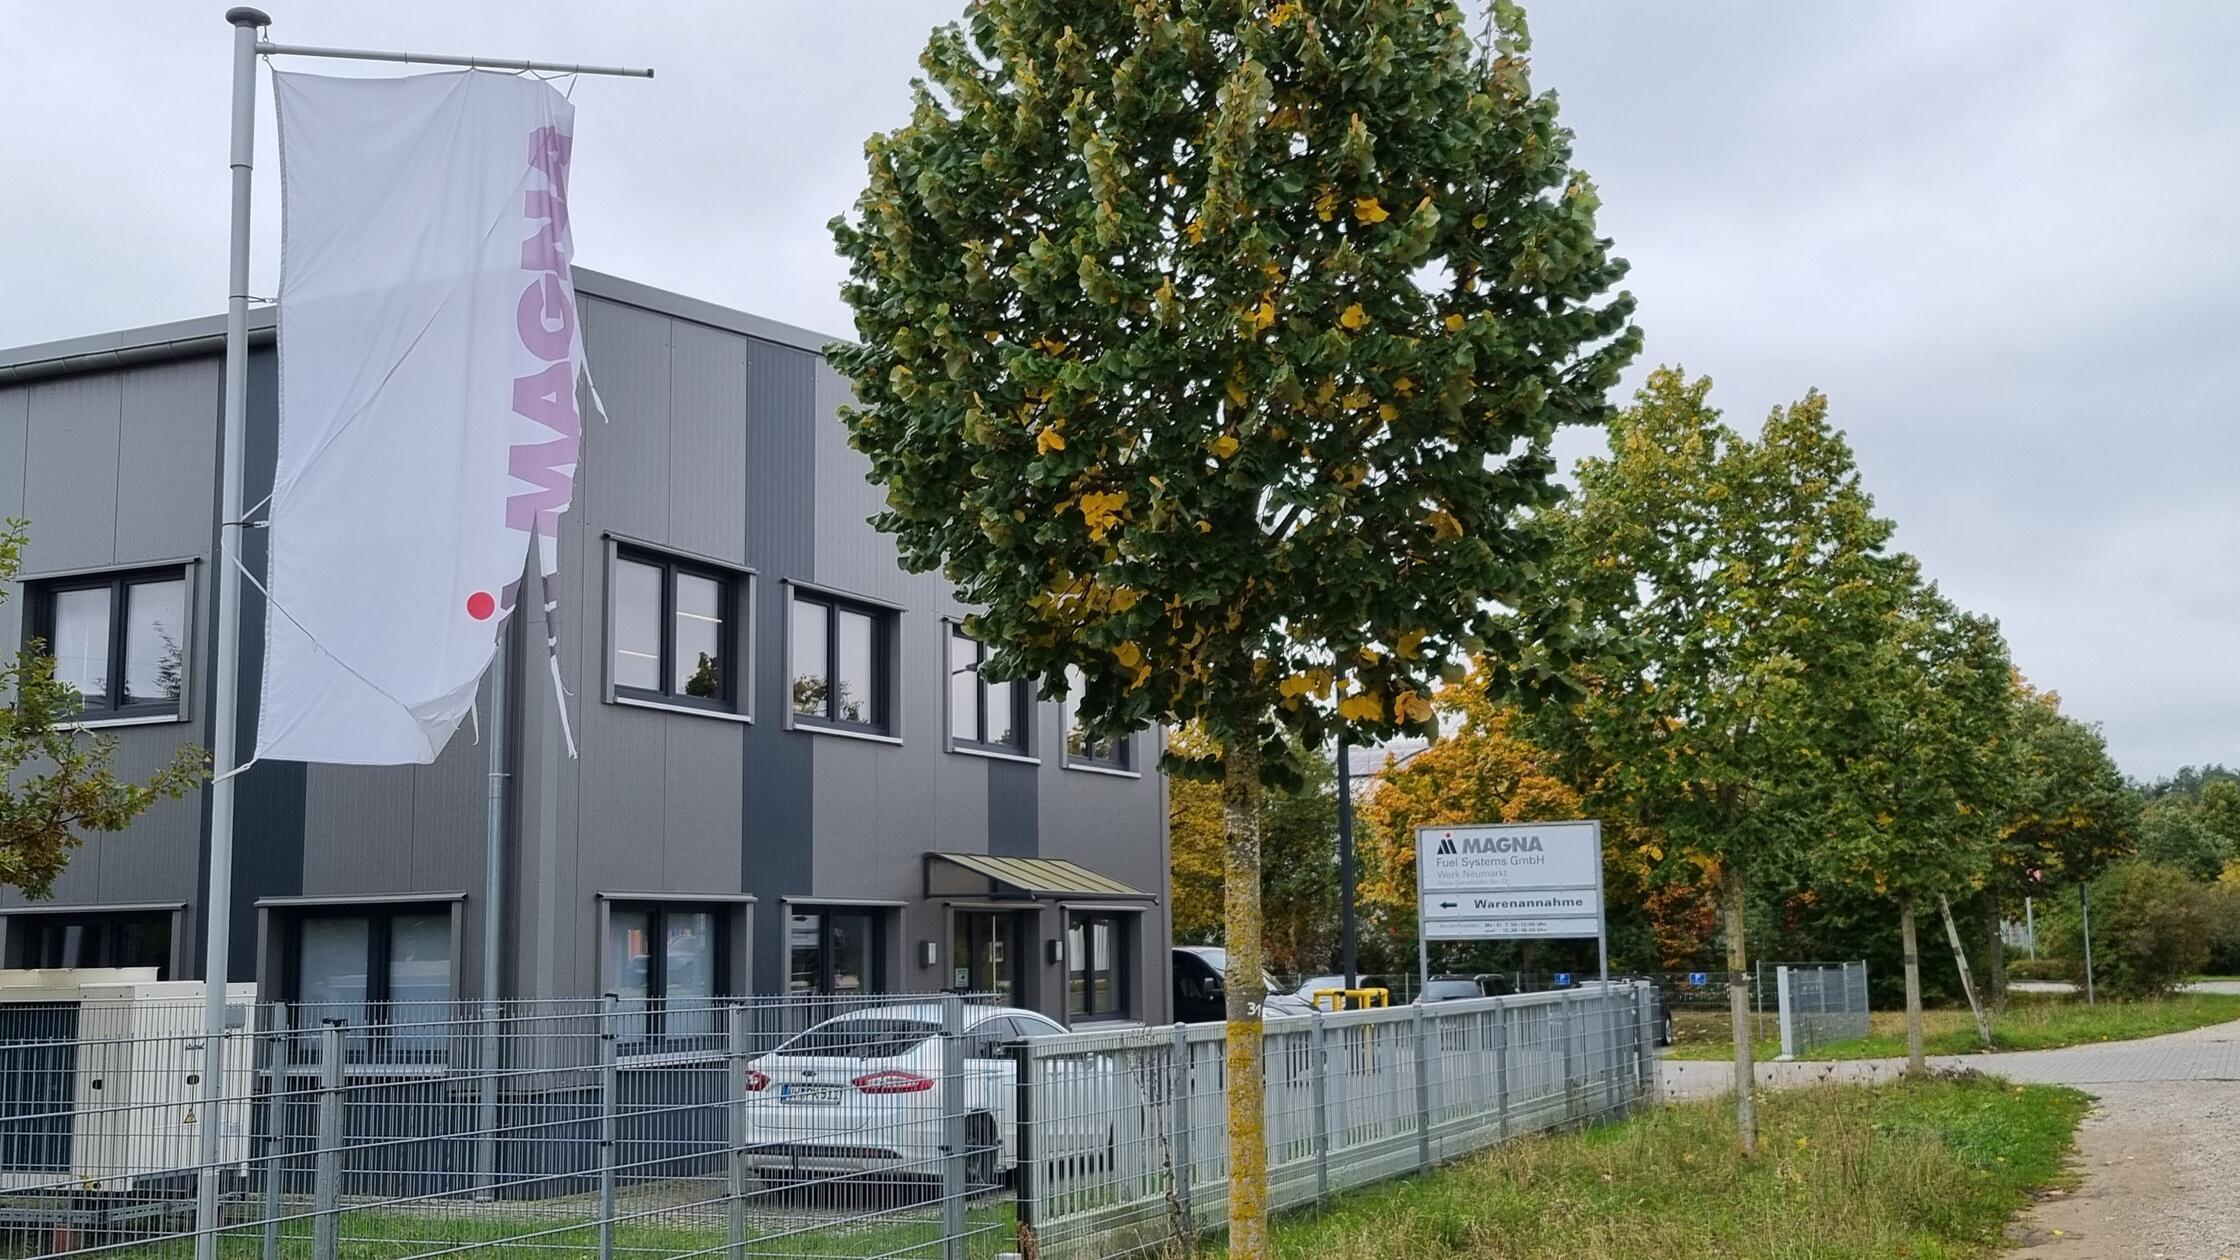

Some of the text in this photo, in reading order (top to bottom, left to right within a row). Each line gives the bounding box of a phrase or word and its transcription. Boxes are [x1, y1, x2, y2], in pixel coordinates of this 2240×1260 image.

[1462, 836, 1544, 854] MAGNA
[1436, 855, 1545, 868] Fuel Systems GmbH
[1462, 869, 1507, 878] Neumarkt
[1474, 897, 1583, 909] Warenannahme
[1247, 1001, 1262, 1017] 31
